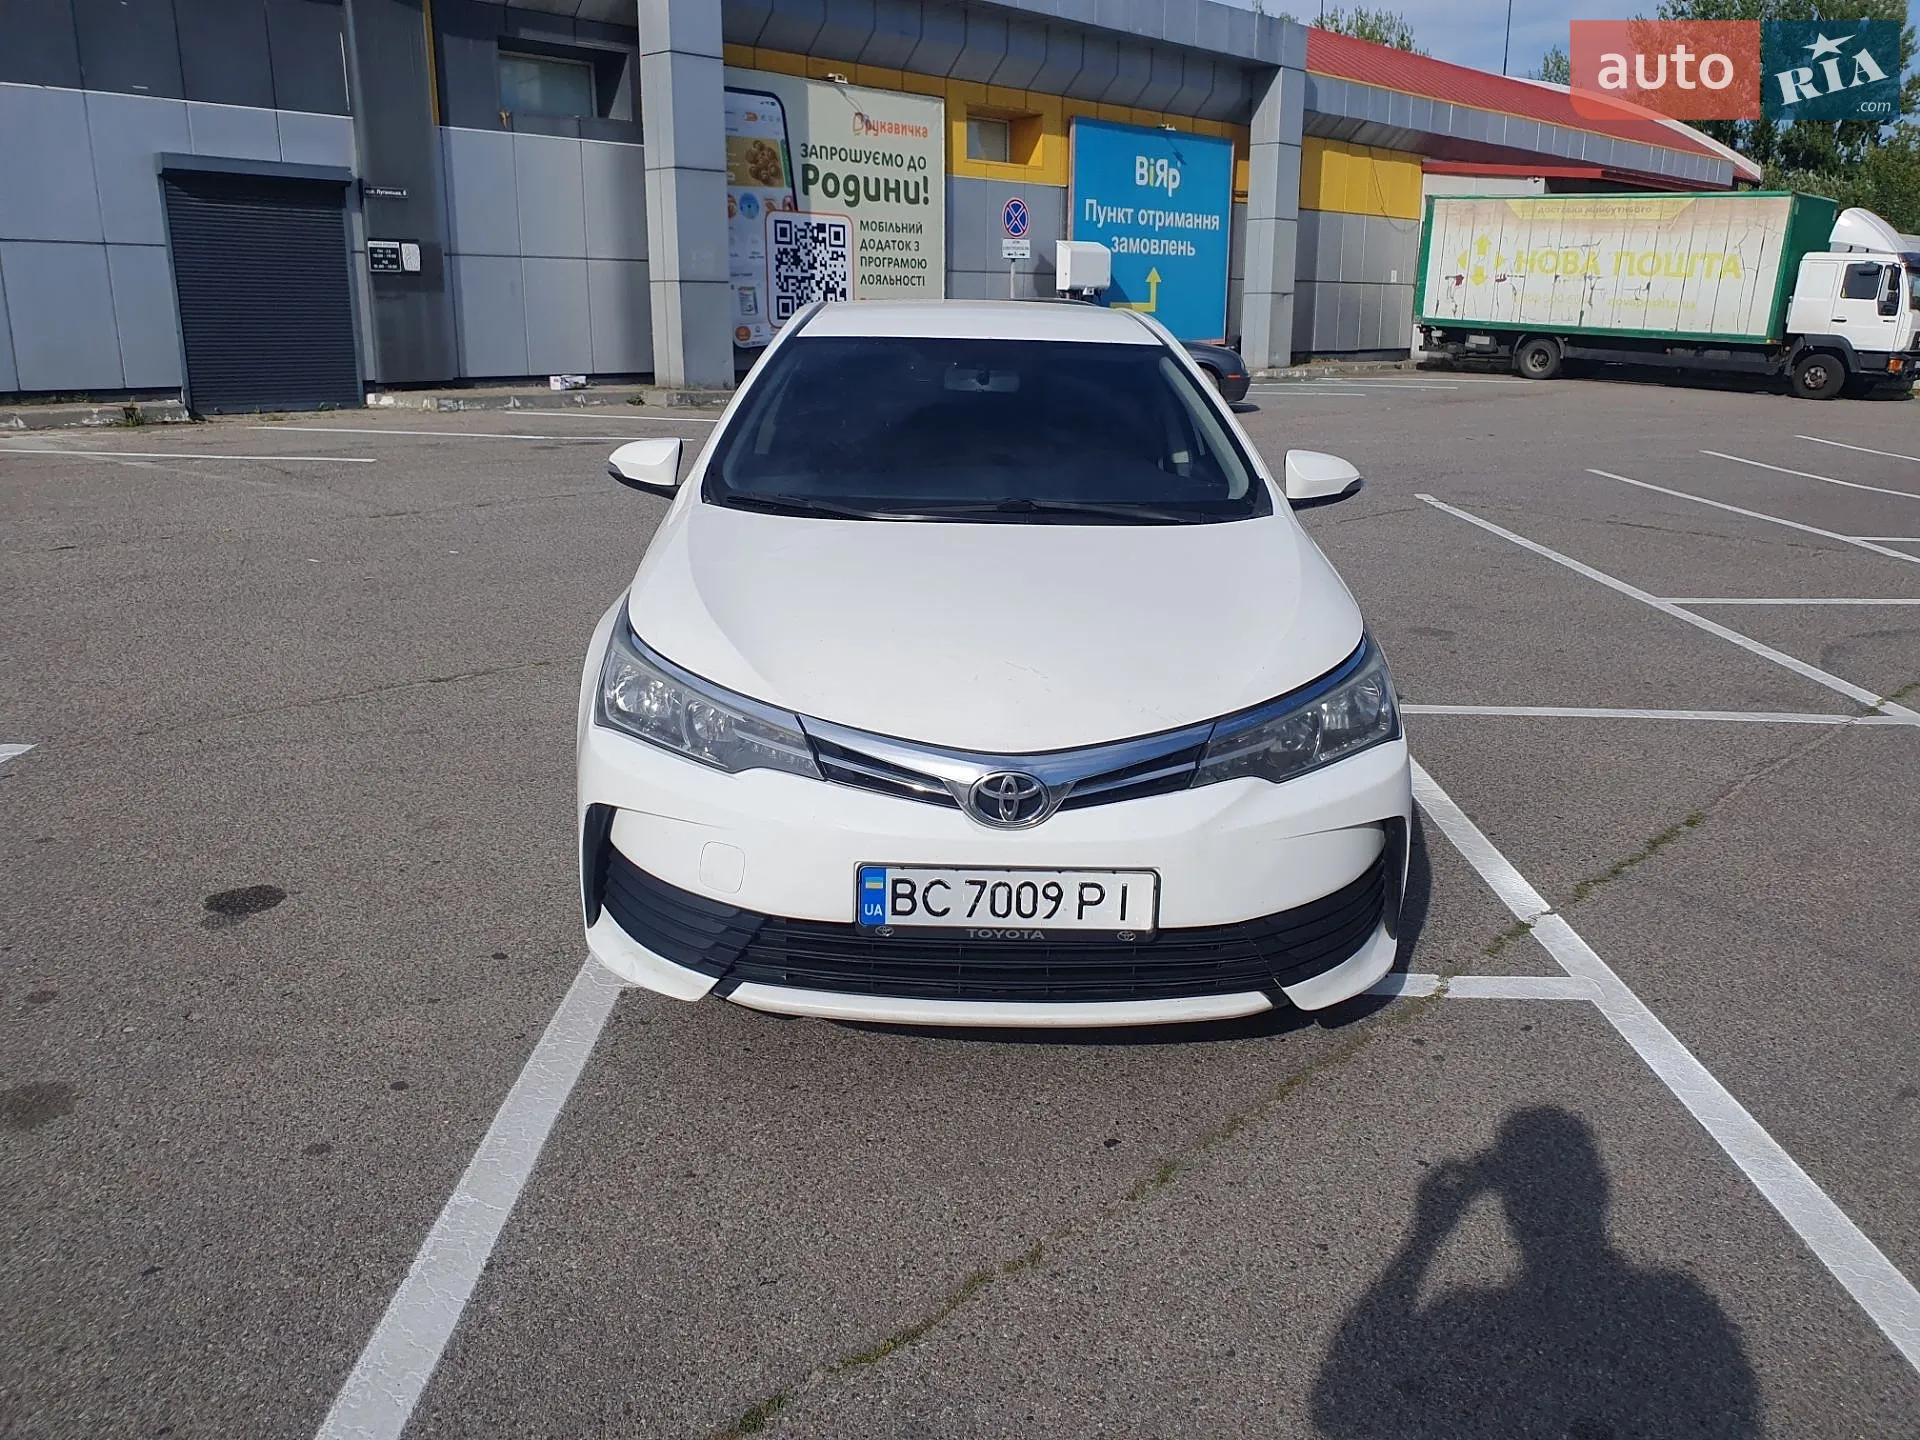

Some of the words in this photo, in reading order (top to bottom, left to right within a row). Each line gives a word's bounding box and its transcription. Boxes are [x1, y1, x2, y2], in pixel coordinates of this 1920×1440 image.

[800, 142, 904, 168] ЗАПРОШУЄМО
[907, 155, 927, 173] ДО
[801, 163, 930, 208] Родини!
[1085, 198, 1134, 228] Пункт
[1138, 207, 1220, 232] отримання
[860, 220, 923, 235] МОБІЛЬНИЙ
[860, 238, 911, 252] ДОДАТОК
[1111, 235, 1196, 257] замовлень
[860, 256, 928, 270] ПРОГРАМОЮ
[1514, 250, 1601, 278] НОВА
[1612, 251, 1744, 280] ПОШТА
[860, 274, 925, 287] ЛОЯЛЬНОСТІ
[891, 878, 951, 918] BC
[965, 879, 1064, 919] 7009
[864, 903, 883, 916] UA
[966, 928, 1045, 940] TOYOTA
